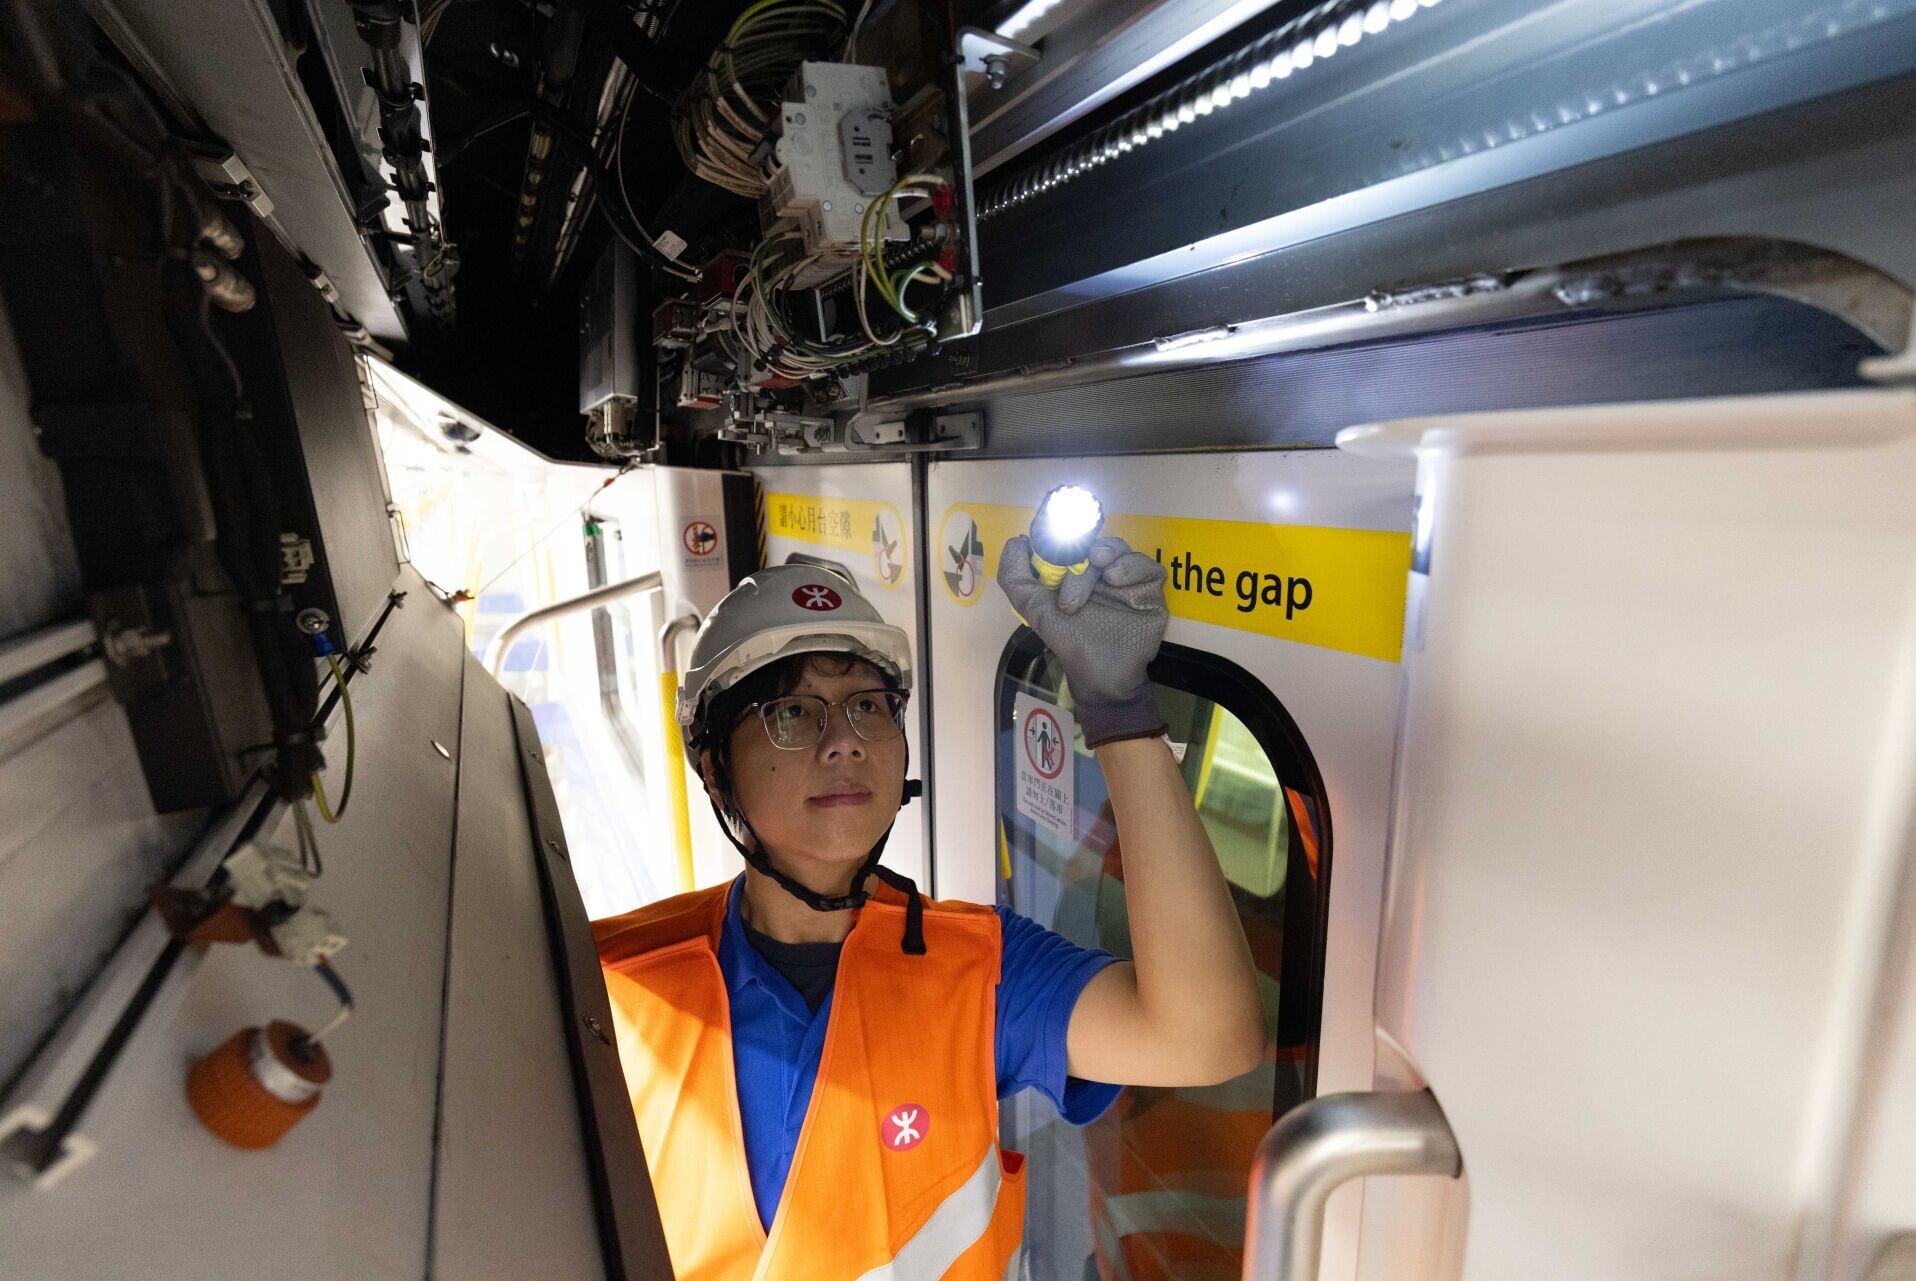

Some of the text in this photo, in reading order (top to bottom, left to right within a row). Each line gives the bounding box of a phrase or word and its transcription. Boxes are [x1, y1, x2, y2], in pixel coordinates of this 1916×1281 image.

[779, 504, 851, 539] 請小心月台空隙
[1171, 552, 1313, 620] the gap
